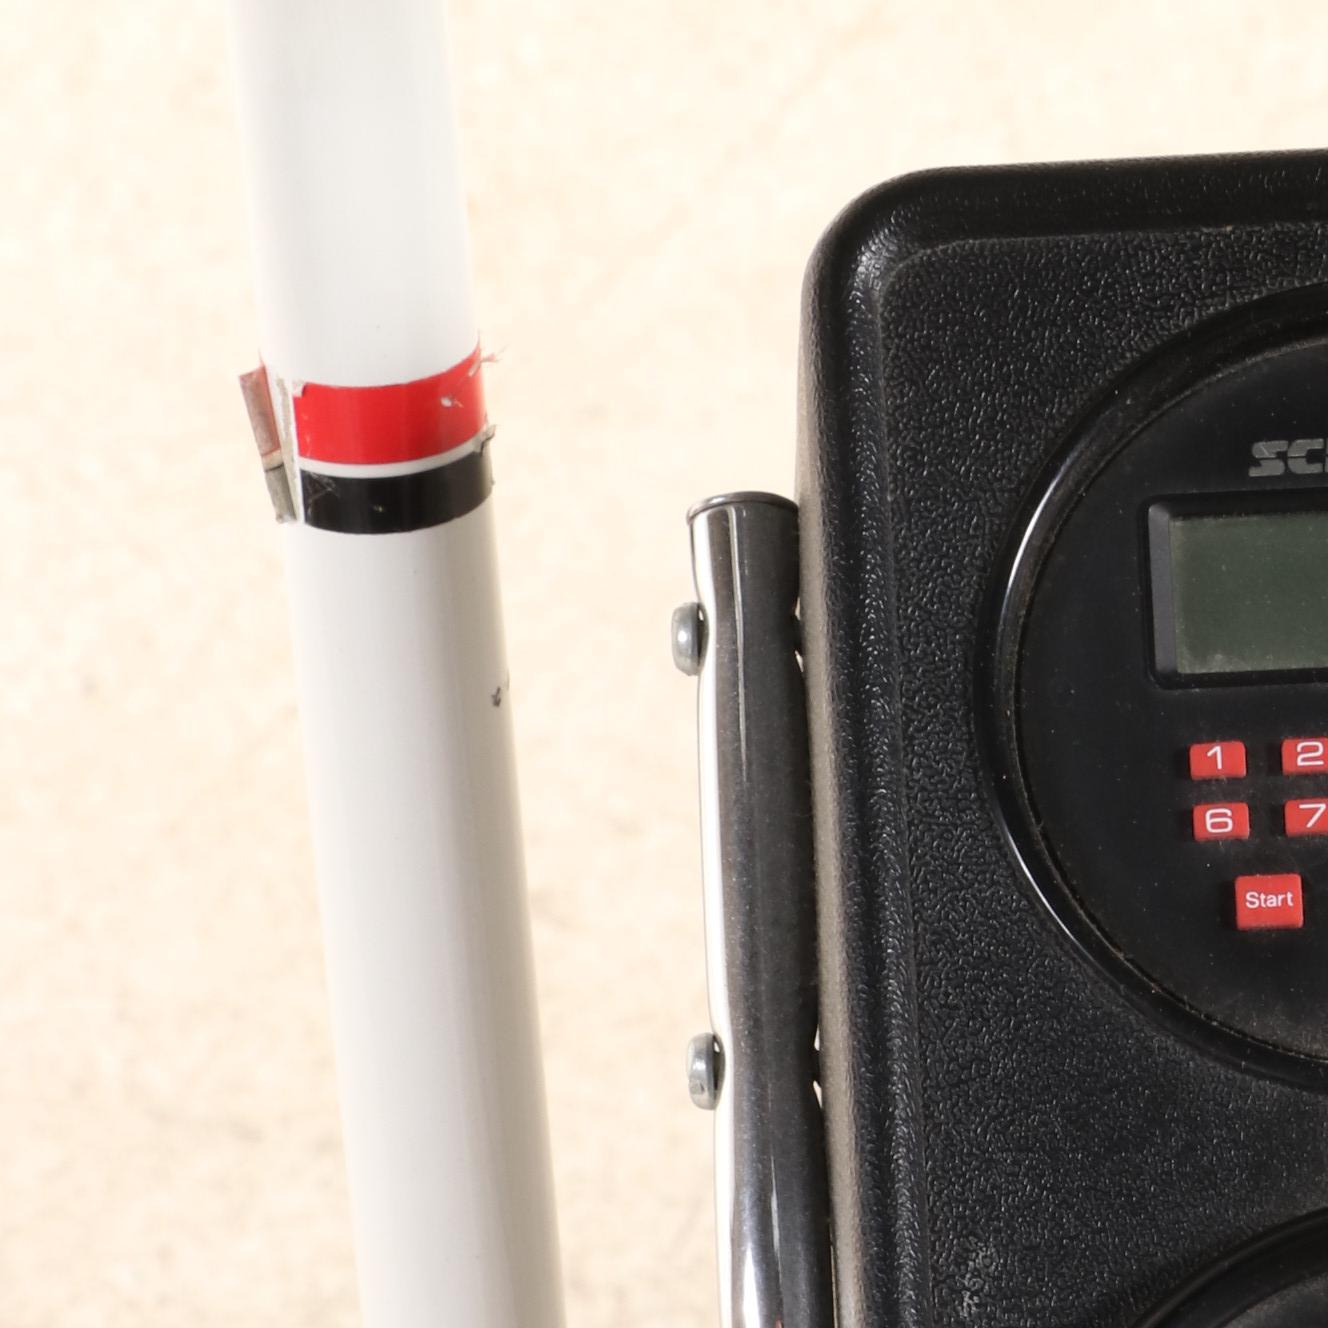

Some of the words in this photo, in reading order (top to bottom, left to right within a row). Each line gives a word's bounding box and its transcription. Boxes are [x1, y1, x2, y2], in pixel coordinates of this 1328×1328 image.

[1206, 745, 1223, 770] 1
[1296, 741, 1325, 766] 2
[1205, 807, 1234, 833] 6
[1299, 803, 1327, 829] 7
[1245, 889, 1294, 910] Start
